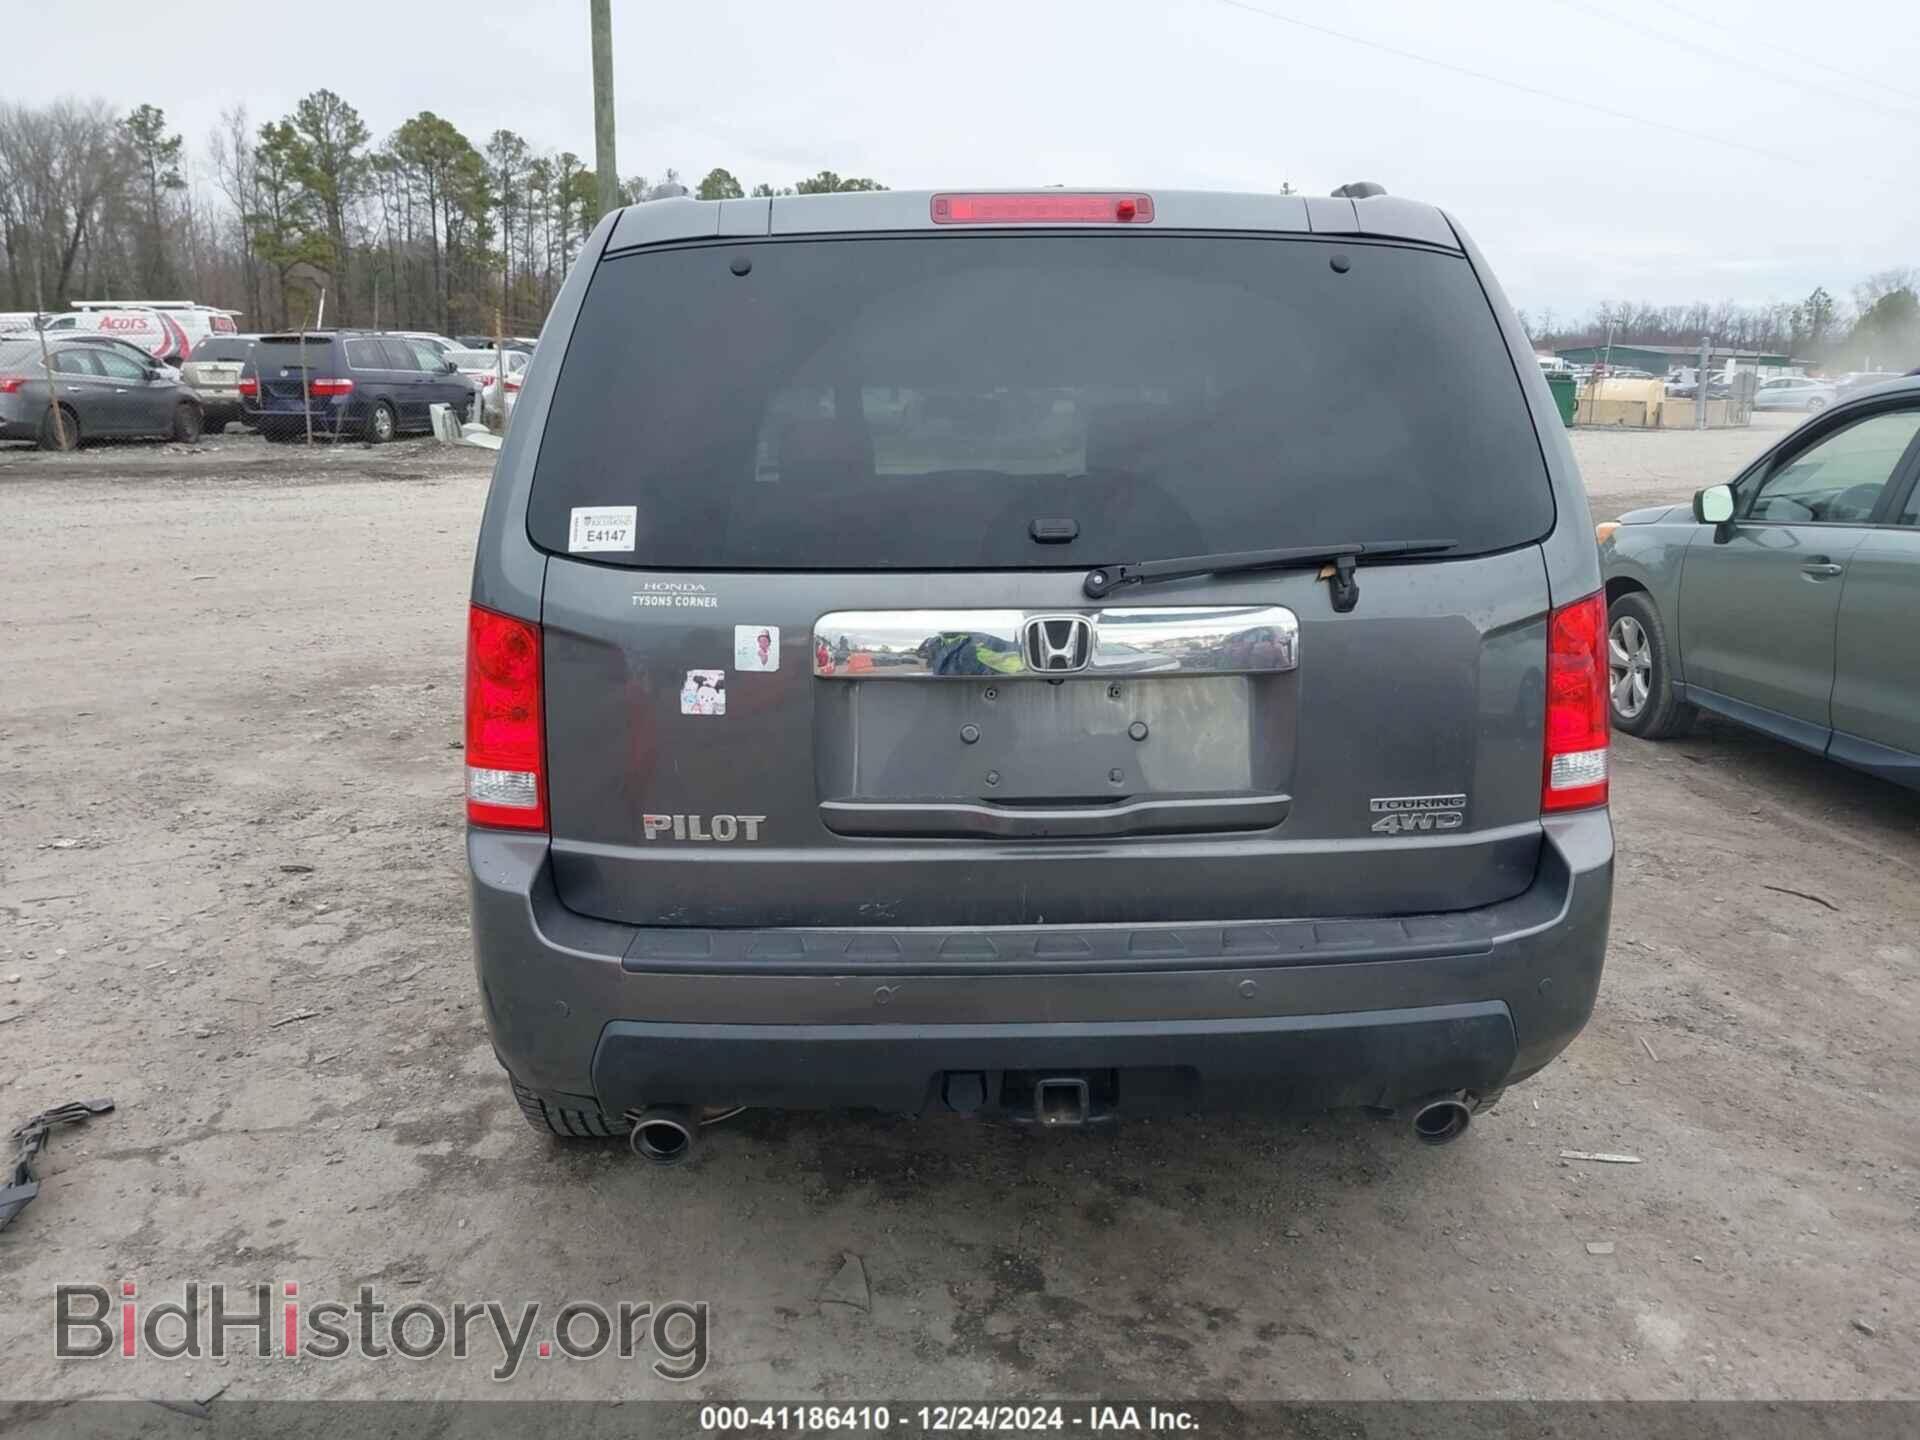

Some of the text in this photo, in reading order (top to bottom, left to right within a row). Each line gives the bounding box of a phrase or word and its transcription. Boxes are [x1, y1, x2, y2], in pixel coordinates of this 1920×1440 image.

[587, 529, 626, 543] E4147
[643, 582, 706, 591] HONDA
[632, 595, 718, 608] TYSONS CORNER
[1372, 797, 1466, 811] TOURING
[642, 814, 767, 841] PILOT
[1371, 811, 1463, 833] 4WD
